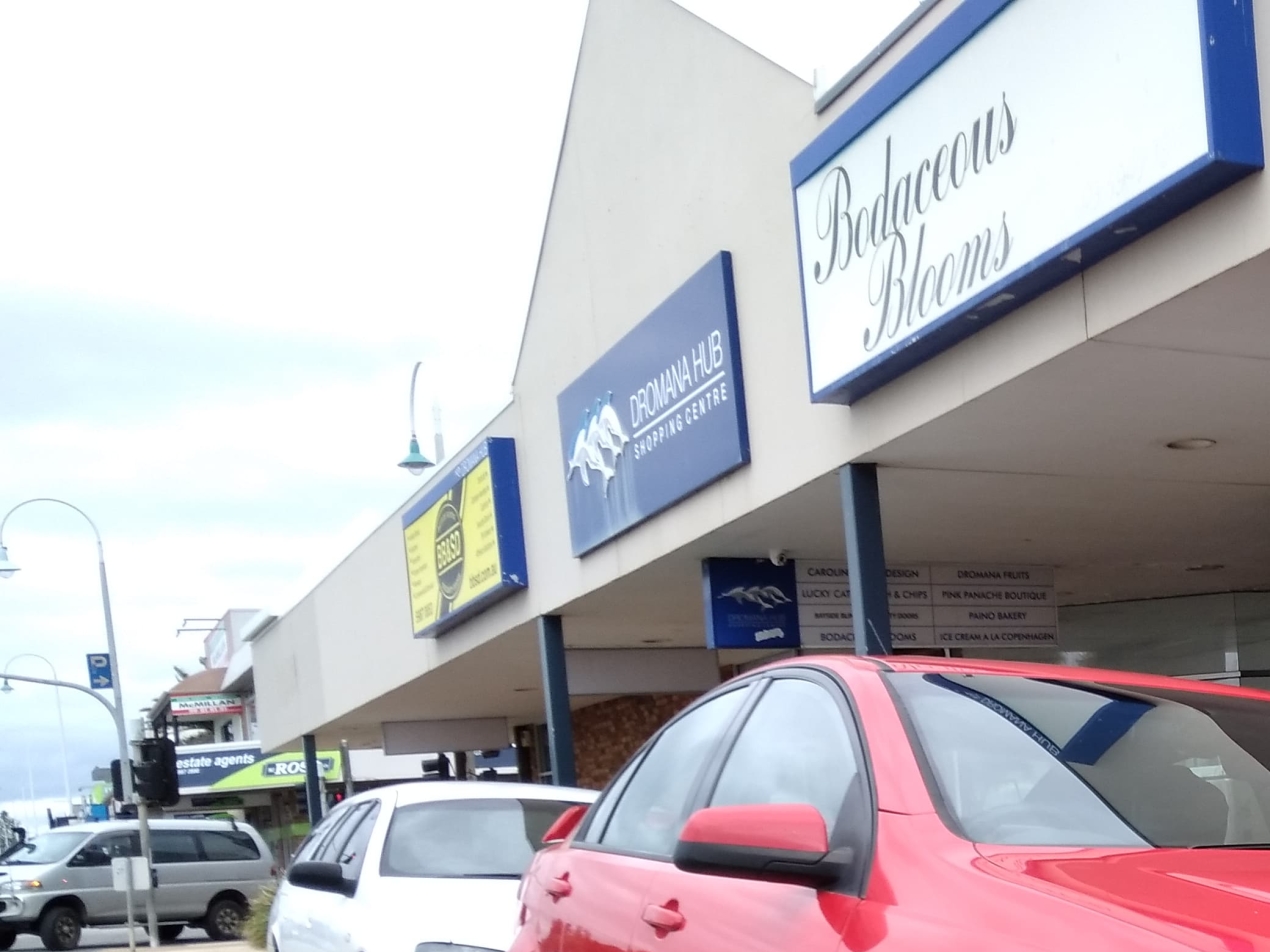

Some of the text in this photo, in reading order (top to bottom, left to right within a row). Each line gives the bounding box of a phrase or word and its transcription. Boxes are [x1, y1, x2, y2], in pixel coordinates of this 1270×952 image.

[814, 91, 1017, 284] Bodaceous
[864, 211, 1013, 352] Blooms
[630, 330, 723, 428] DROMANA HUB
[634, 382, 728, 460] SHOPPING CENTRE
[957, 570, 1030, 580] DROMANA FRUITS
[802, 589, 830, 598] LUCKY
[902, 591, 928, 599] CHIPS
[942, 591, 1047, 600] PINK PANACHE BOUTIQUE
[969, 612, 1027, 620] PAINO BAKERY
[941, 632, 1054, 641] ICE CREAM A LA COPENHAGEN
[176, 753, 255, 769] estate agents
